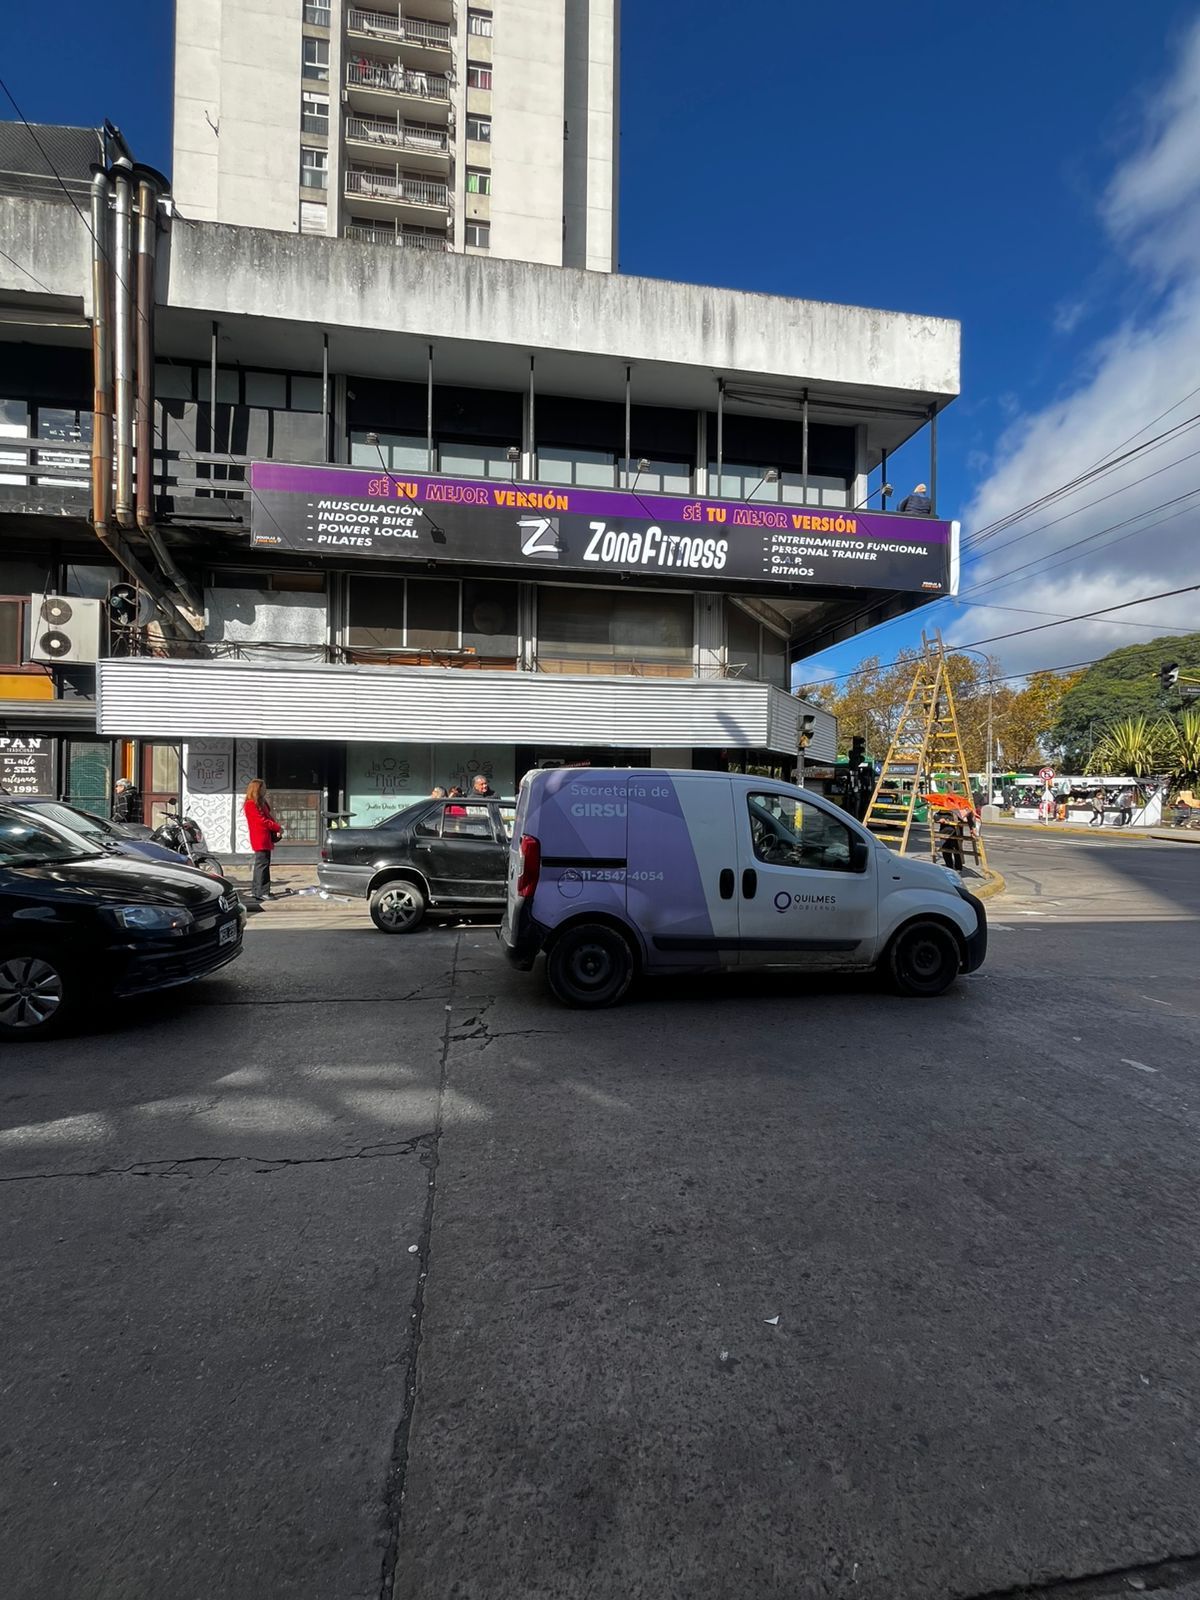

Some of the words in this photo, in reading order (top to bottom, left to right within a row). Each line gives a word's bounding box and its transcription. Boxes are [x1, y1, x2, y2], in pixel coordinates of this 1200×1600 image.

[368, 476, 390, 497] SÉ
[395, 482, 418, 499] TU
[426, 483, 489, 505] MEJOR
[493, 489, 569, 511] VERSIÓN
[317, 501, 423, 516] MUSCULACIÓN
[317, 512, 378, 524] INDOOR
[382, 516, 414, 527] BIKE
[682, 502, 702, 521] SÉ
[706, 507, 727, 523] TU
[733, 509, 788, 528] MEJOR
[791, 514, 857, 534] VERSIÓN
[317, 524, 370, 535] POWER
[374, 528, 419, 538] LOCAL
[317, 535, 373, 547] PILATES
[771, 534, 865, 550] ENTRENAMIENTO
[867, 542, 928, 556] FUNCIONAL
[771, 545, 829, 557] PERSONAL
[832, 549, 877, 561] TRAINER
[771, 565, 815, 576] RITMOS
[651, 786, 670, 798] de
[570, 803, 628, 817] GIRSU
[580, 870, 665, 882] 11-2547-4054
[793, 894, 837, 904] QUILMES
